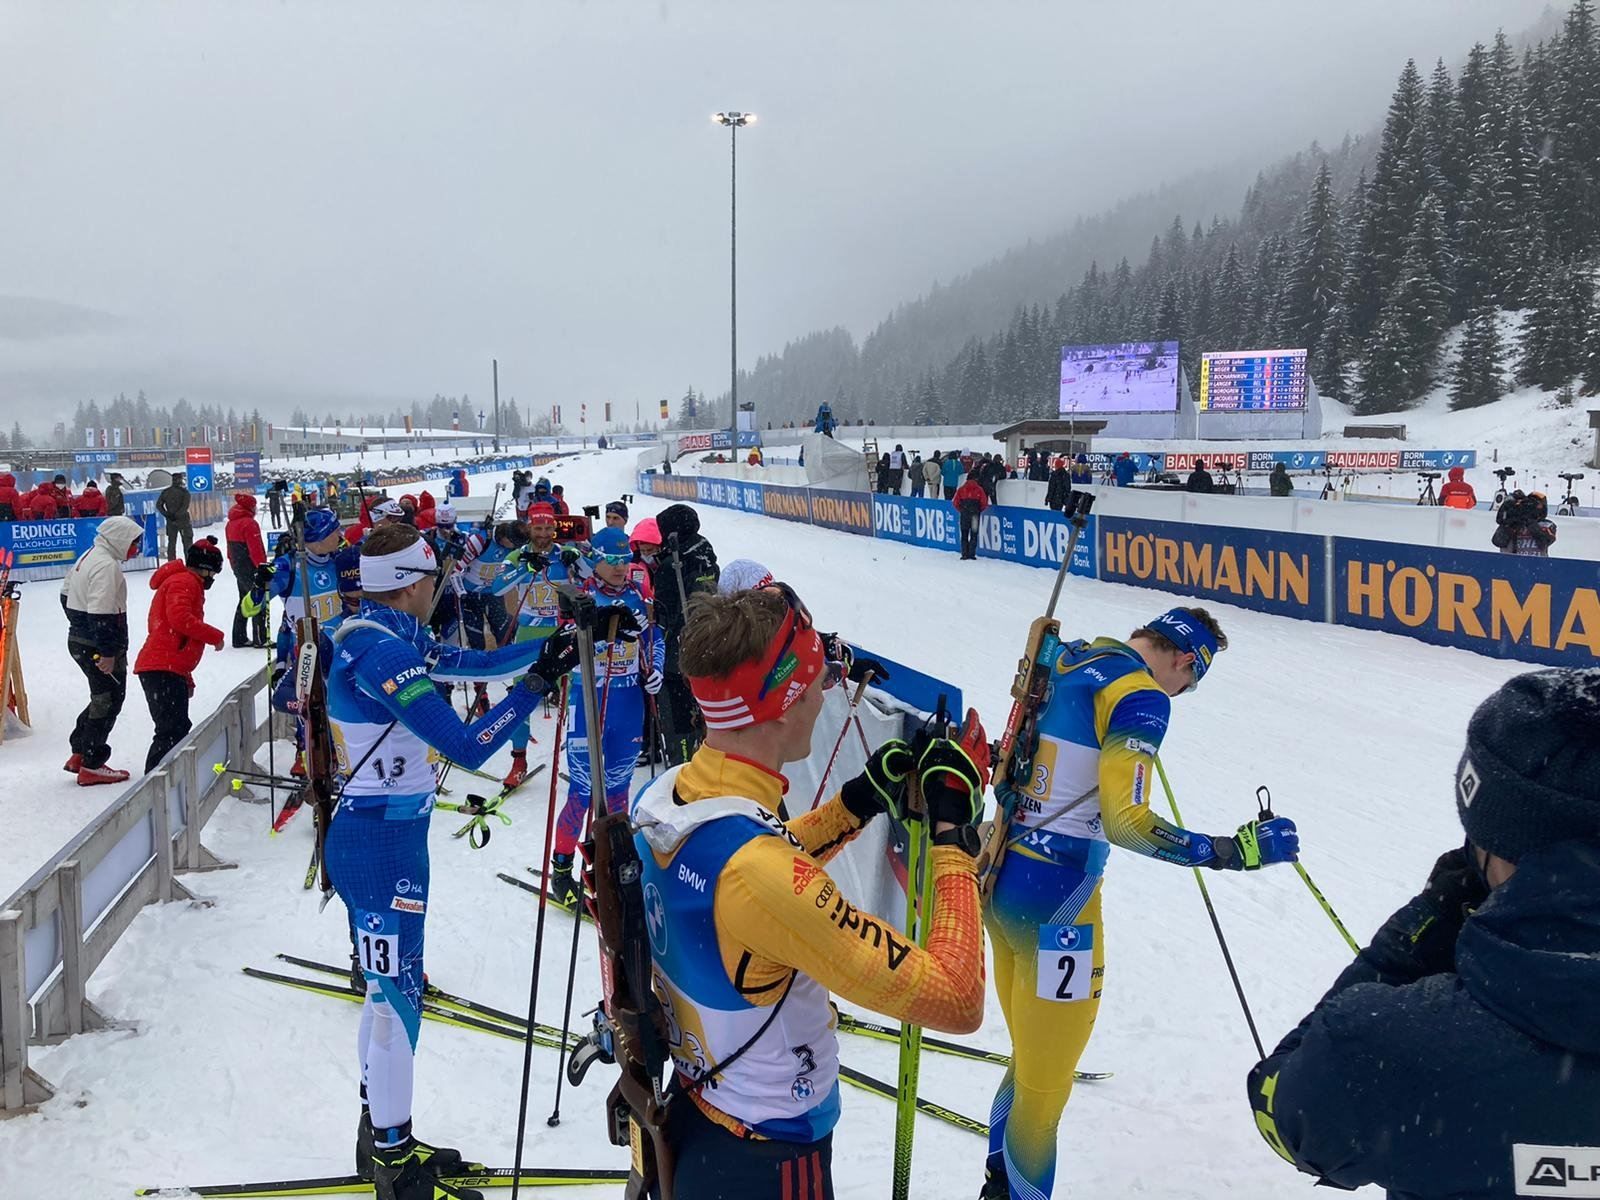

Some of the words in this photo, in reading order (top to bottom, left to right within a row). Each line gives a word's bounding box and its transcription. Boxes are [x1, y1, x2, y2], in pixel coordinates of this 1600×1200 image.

[1166, 453, 1246, 471] BAUHAUS
[1252, 453, 1273, 461] BORN
[1327, 452, 1398, 468] BAUHAUS
[1403, 452, 1425, 460] BORN
[1403, 460, 1437, 468] ELECTRIC
[427, 471, 444, 480] DKB
[480, 463, 498, 473] DKB
[875, 502, 901, 534] DKB
[915, 507, 945, 542] DKB
[1003, 517, 1013, 529] Das
[11, 523, 77, 540] ERDINGER
[979, 515, 1001, 551] KB
[1003, 533, 1016, 542] kann
[12, 539, 77, 549] ALKOHOLFREI
[1003, 544, 1017, 555] Bank
[1023, 519, 1071, 563] DKB
[31, 553, 63, 561] ZITRONE
[1074, 554, 1090, 568] Bank
[1105, 530, 1310, 605] HÖRMANN
[530, 585, 553, 604] 12
[311, 596, 334, 618] 11
[613, 640, 627, 657] 4
[626, 674, 638, 687] iX
[1084, 666, 1107, 682] BMW
[781, 682, 807, 711] adidas
[488, 711, 515, 736] LAPUA
[371, 755, 407, 780] 13
[1033, 764, 1050, 796] 3
[677, 863, 707, 893] BMW
[830, 896, 912, 972] Audi
[362, 935, 391, 975] 13
[1055, 955, 1076, 1000] 2
